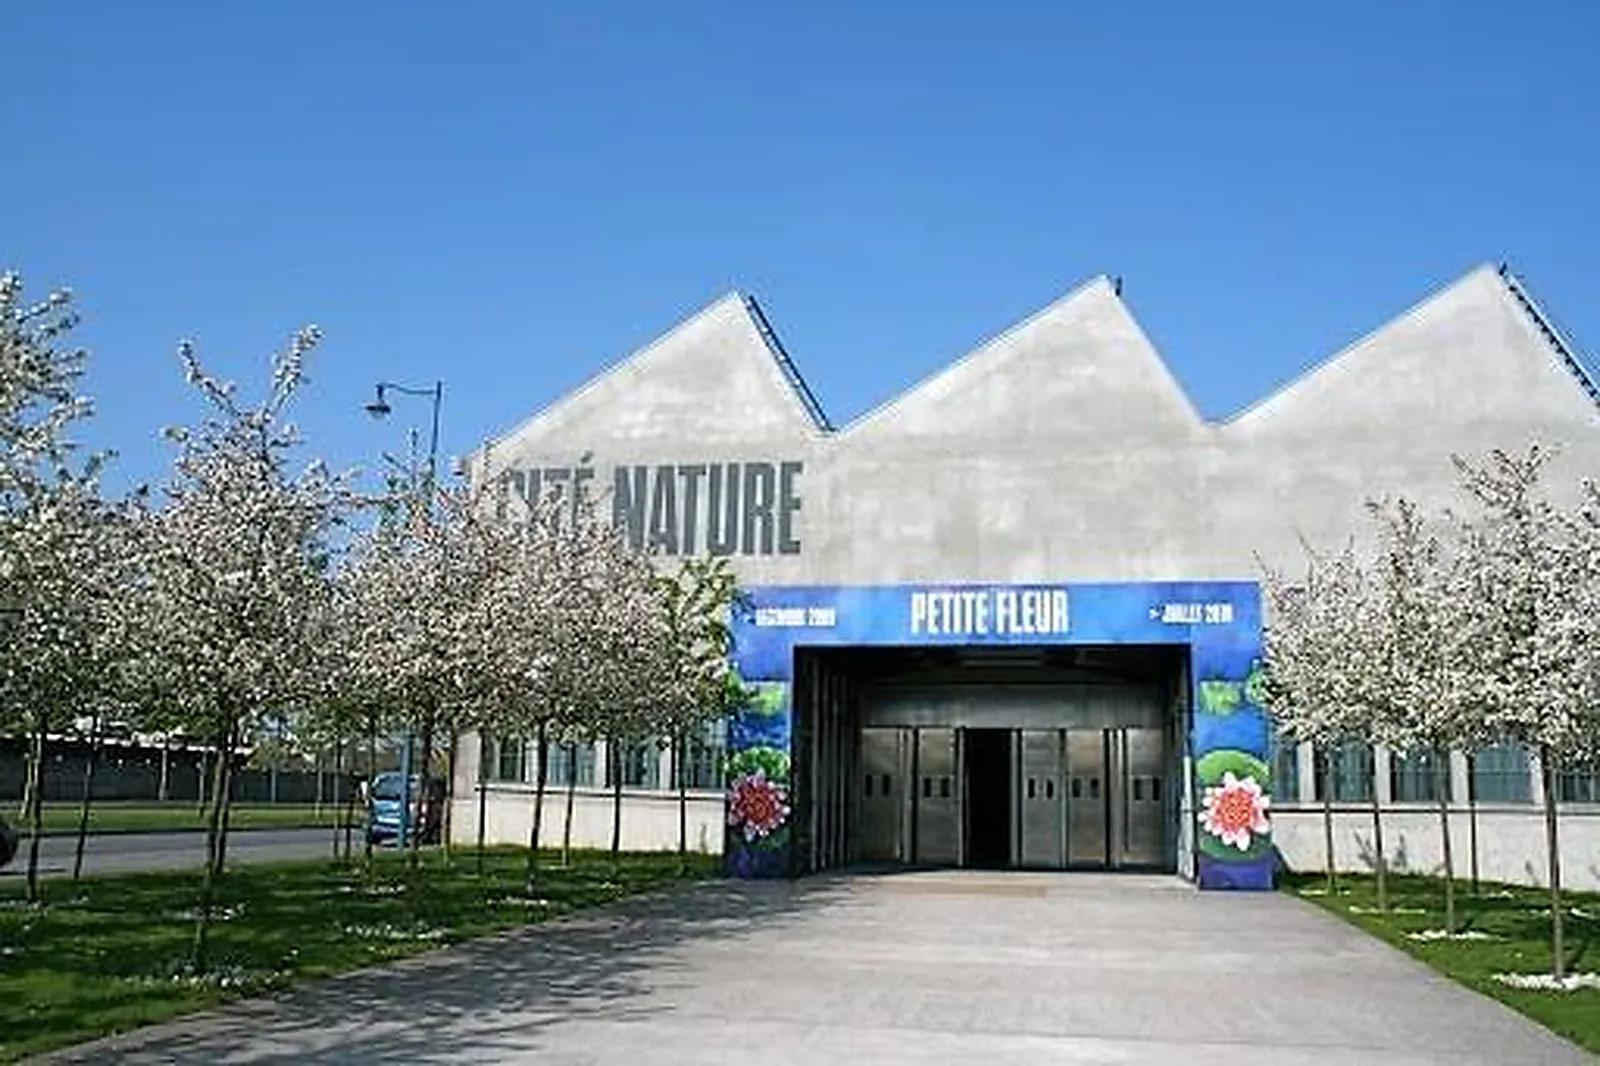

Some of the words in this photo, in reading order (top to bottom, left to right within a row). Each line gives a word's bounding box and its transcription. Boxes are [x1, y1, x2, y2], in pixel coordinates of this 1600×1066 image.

[613, 461, 803, 555] NATURE
[911, 592, 988, 634] PETITE
[997, 590, 1068, 633] FLEUR
